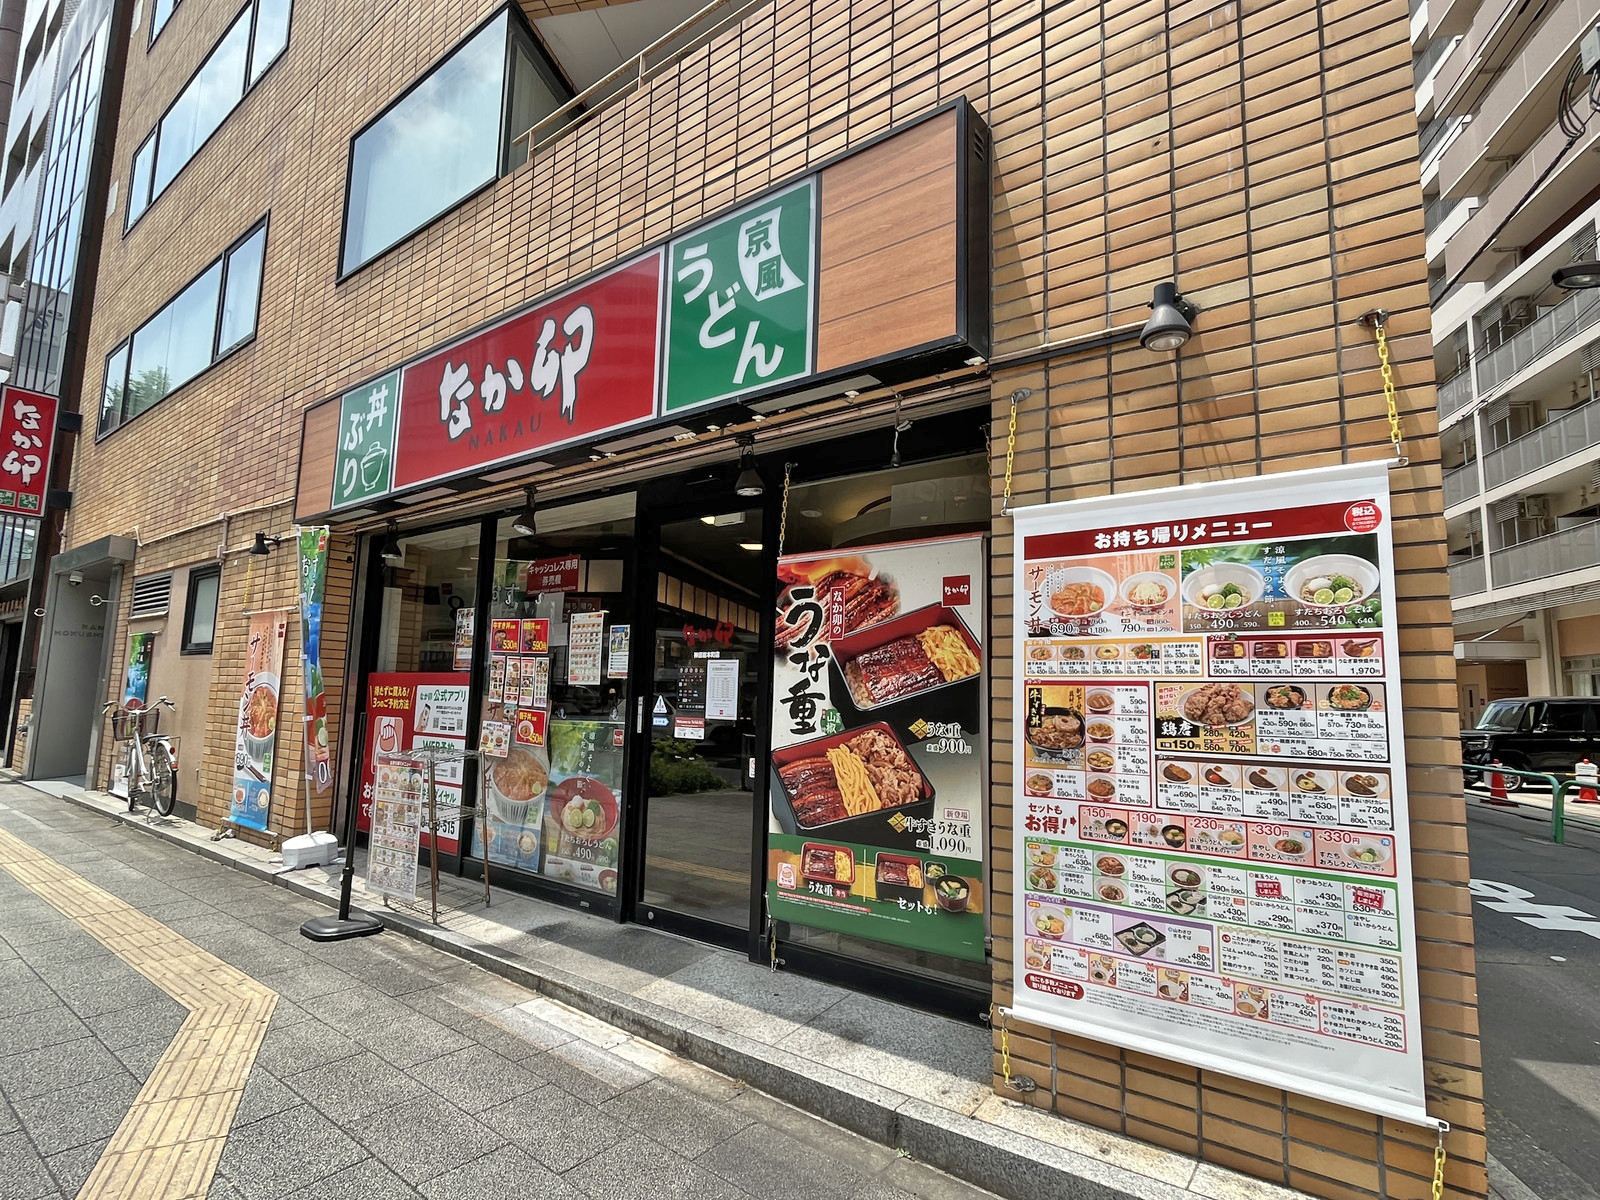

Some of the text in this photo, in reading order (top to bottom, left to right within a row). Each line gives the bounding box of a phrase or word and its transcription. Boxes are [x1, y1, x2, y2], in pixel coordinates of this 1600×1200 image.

[745, 217, 784, 296] 京風
[677, 242, 784, 384] うどん
[438, 304, 594, 440] なか卯
[468, 414, 542, 450] NAKAU
[2, 400, 42, 486] なか卯
[1352, 506, 1376, 516] 税込
[1094, 521, 1273, 550] お持ち帰りメニュー
[529, 559, 578, 574] キャッシュレス専用
[1275, 546, 1286, 598] 涼風そよぐ、
[945, 583, 969, 595] なか卯
[1029, 566, 1044, 633] サーモン丼
[833, 590, 843, 635] なか卯の
[1121, 624, 1145, 632] 790円
[781, 588, 830, 735] うな重
[434, 690, 466, 702] 公式アプリ
[1030, 689, 1041, 727] 牛すき丼
[927, 722, 961, 738] うな重
[1229, 730, 1250, 738] 420円
[939, 739, 971, 754] 900円
[1172, 740, 1201, 749] 150円
[1222, 794, 1240, 802] 570円
[947, 811, 968, 819] 新登場
[1028, 803, 1062, 814] セットも
[1367, 806, 1389, 814] 730円
[905, 816, 971, 838] 牛すきうな重
[1025, 814, 1067, 834] お得!
[929, 836, 971, 853] 1,090円
[809, 882, 833, 896] うな重
